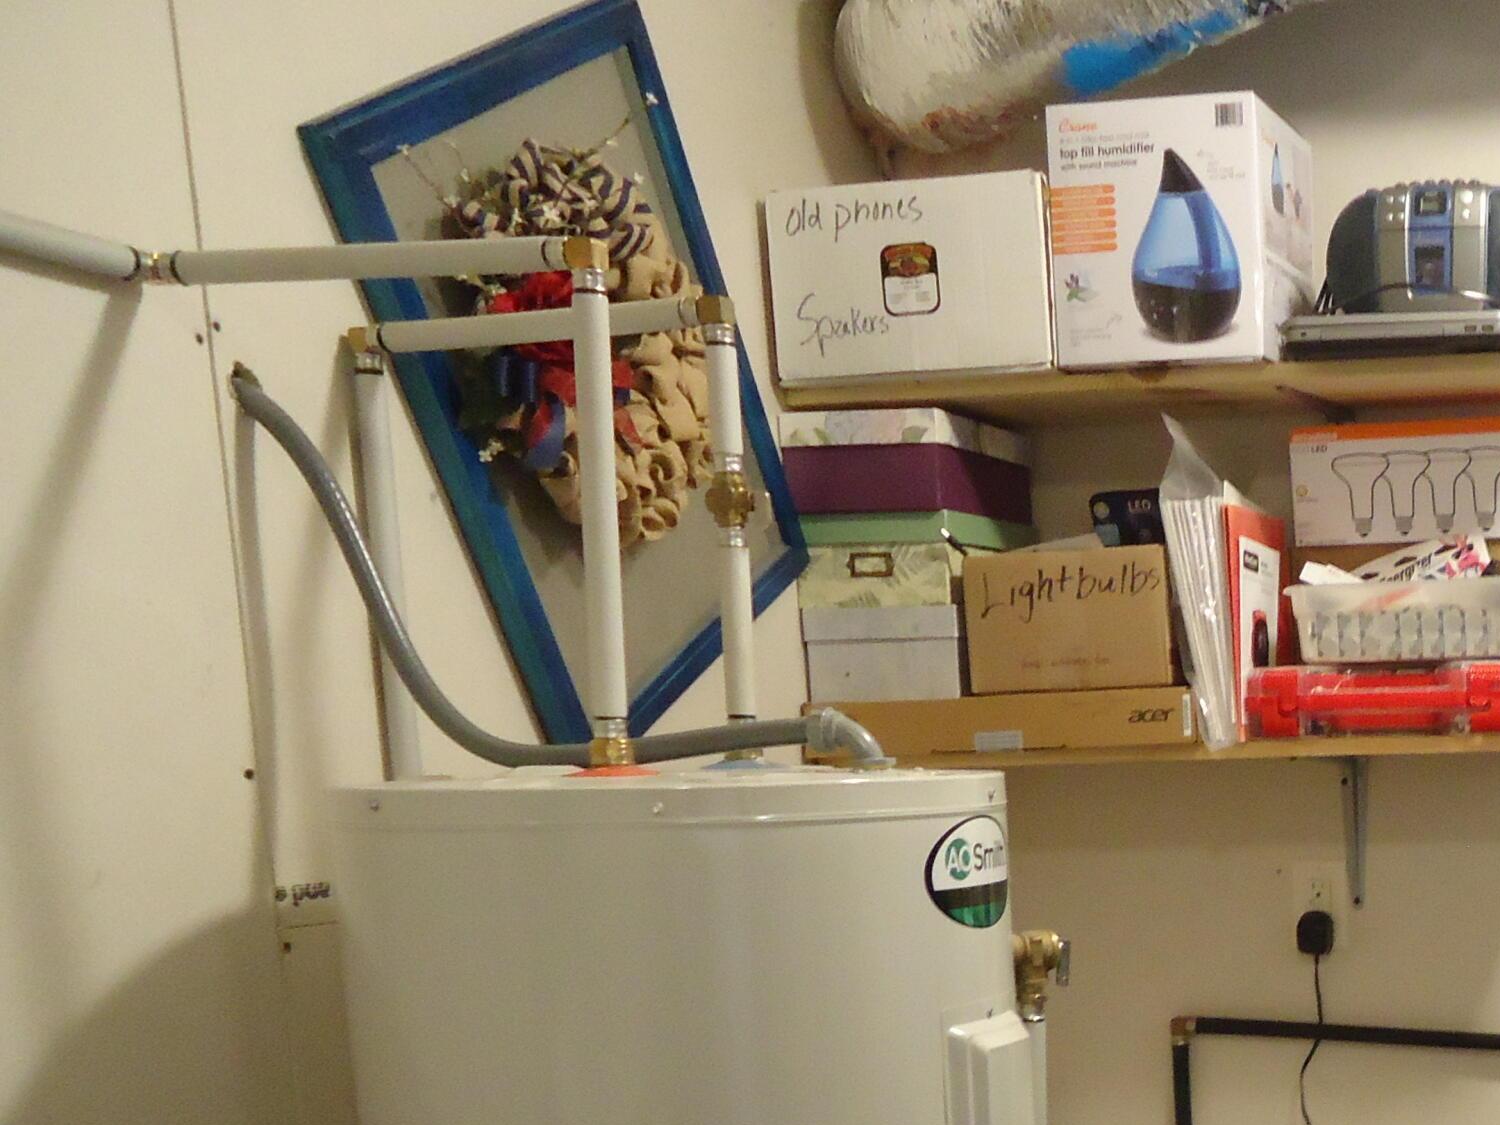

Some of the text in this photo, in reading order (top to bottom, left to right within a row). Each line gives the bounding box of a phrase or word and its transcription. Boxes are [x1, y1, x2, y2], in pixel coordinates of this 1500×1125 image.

[1059, 142, 1155, 161] top fill humidifier
[785, 195, 923, 243] Old phones
[1127, 708, 1175, 724] acer
